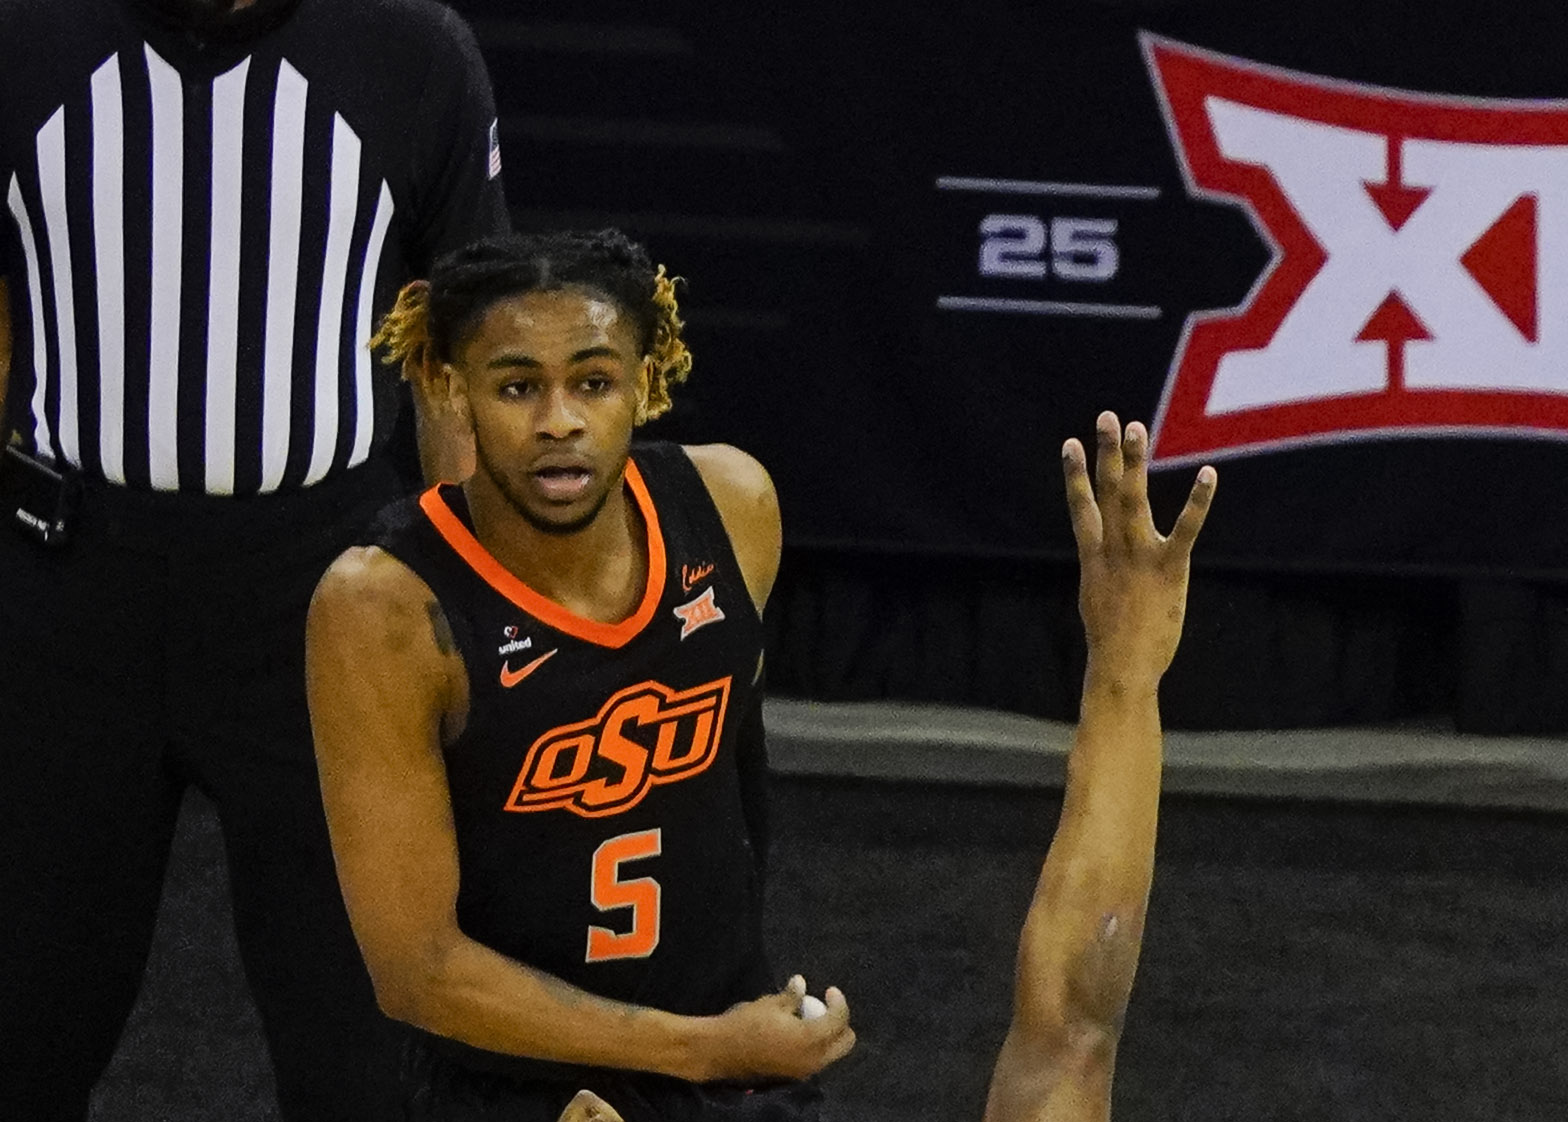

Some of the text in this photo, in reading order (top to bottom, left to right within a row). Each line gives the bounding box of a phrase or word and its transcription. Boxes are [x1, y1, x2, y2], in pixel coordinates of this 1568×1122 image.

[977, 213, 1120, 282] 25
[498, 636, 532, 655] united
[511, 684, 725, 812] OSU
[585, 827, 662, 963] 5
